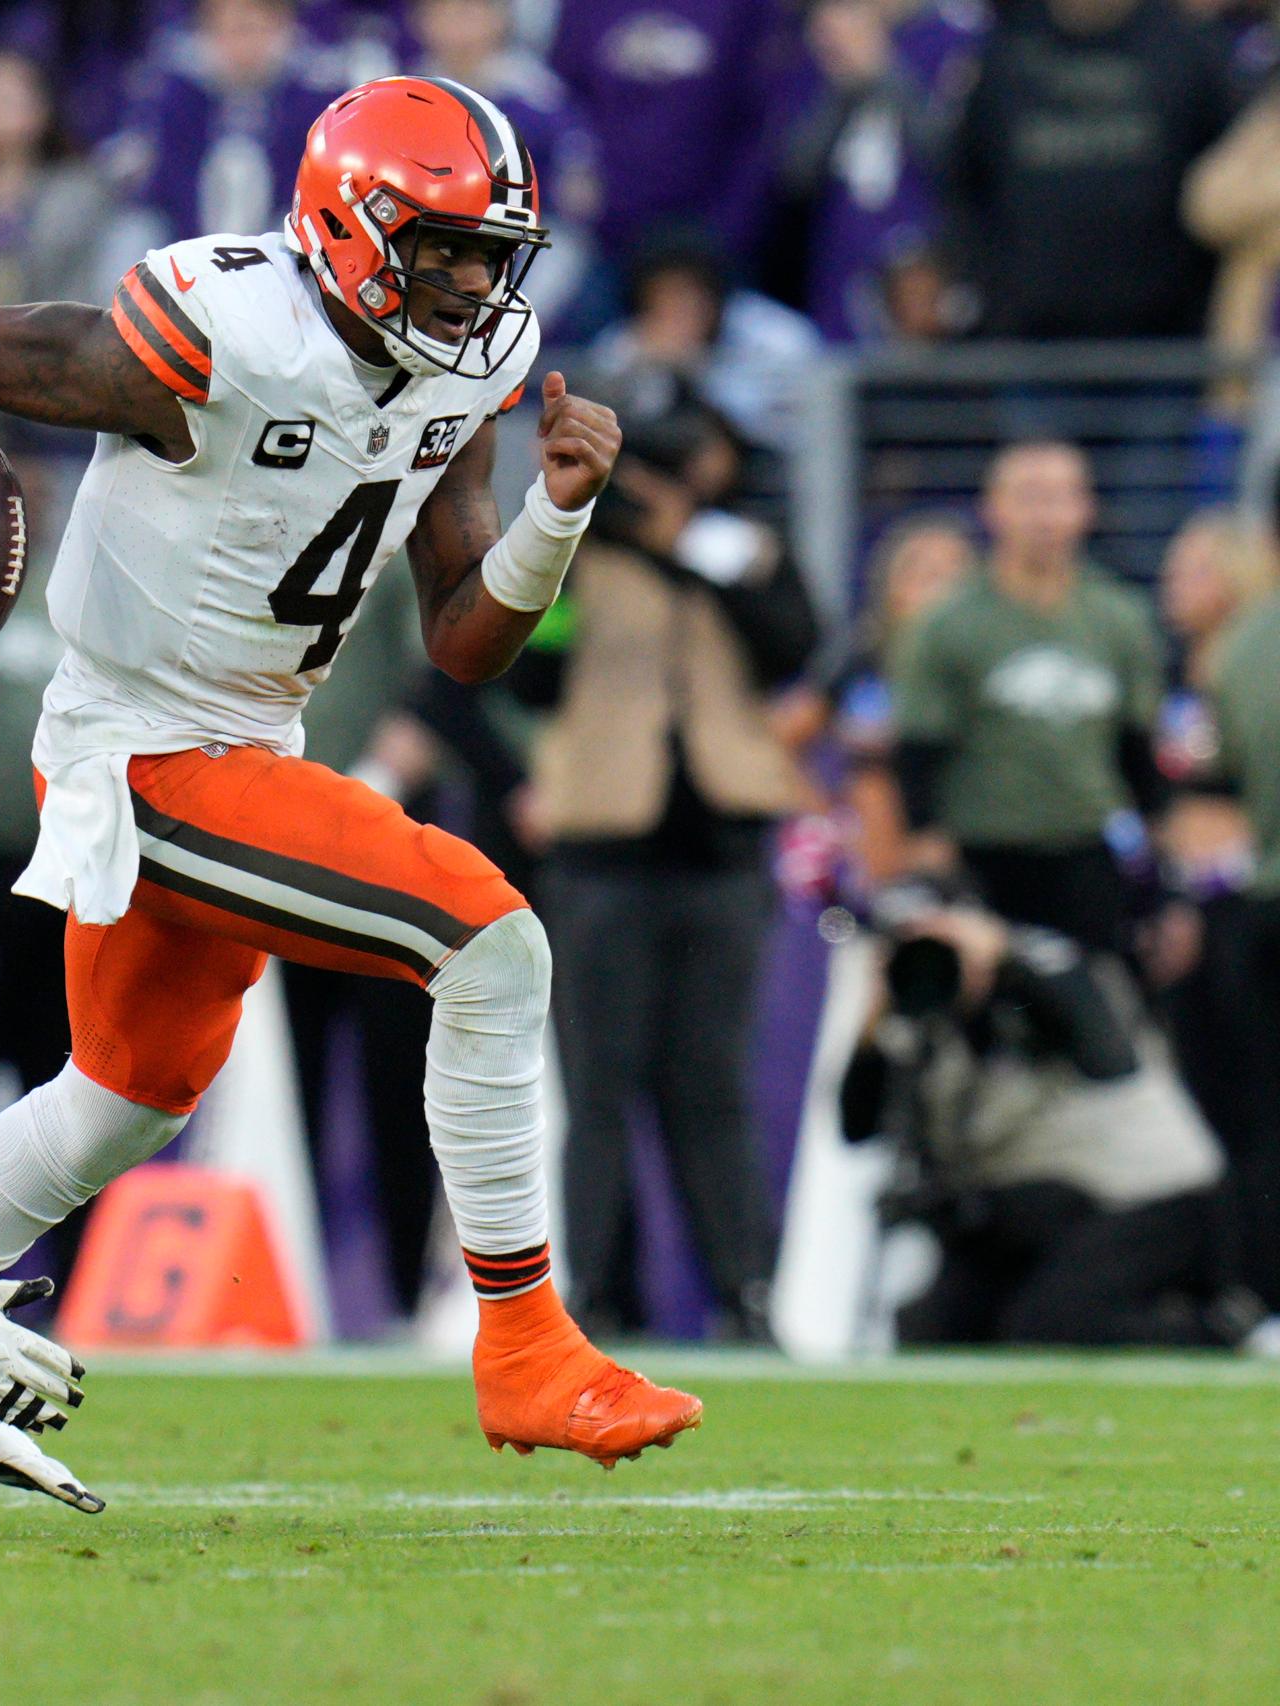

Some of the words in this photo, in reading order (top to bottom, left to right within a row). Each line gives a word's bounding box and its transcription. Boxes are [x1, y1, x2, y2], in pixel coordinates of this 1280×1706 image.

[210, 246, 274, 273] 4
[262, 423, 312, 458] C
[420, 419, 464, 458] 32
[267, 478, 404, 675] 4
